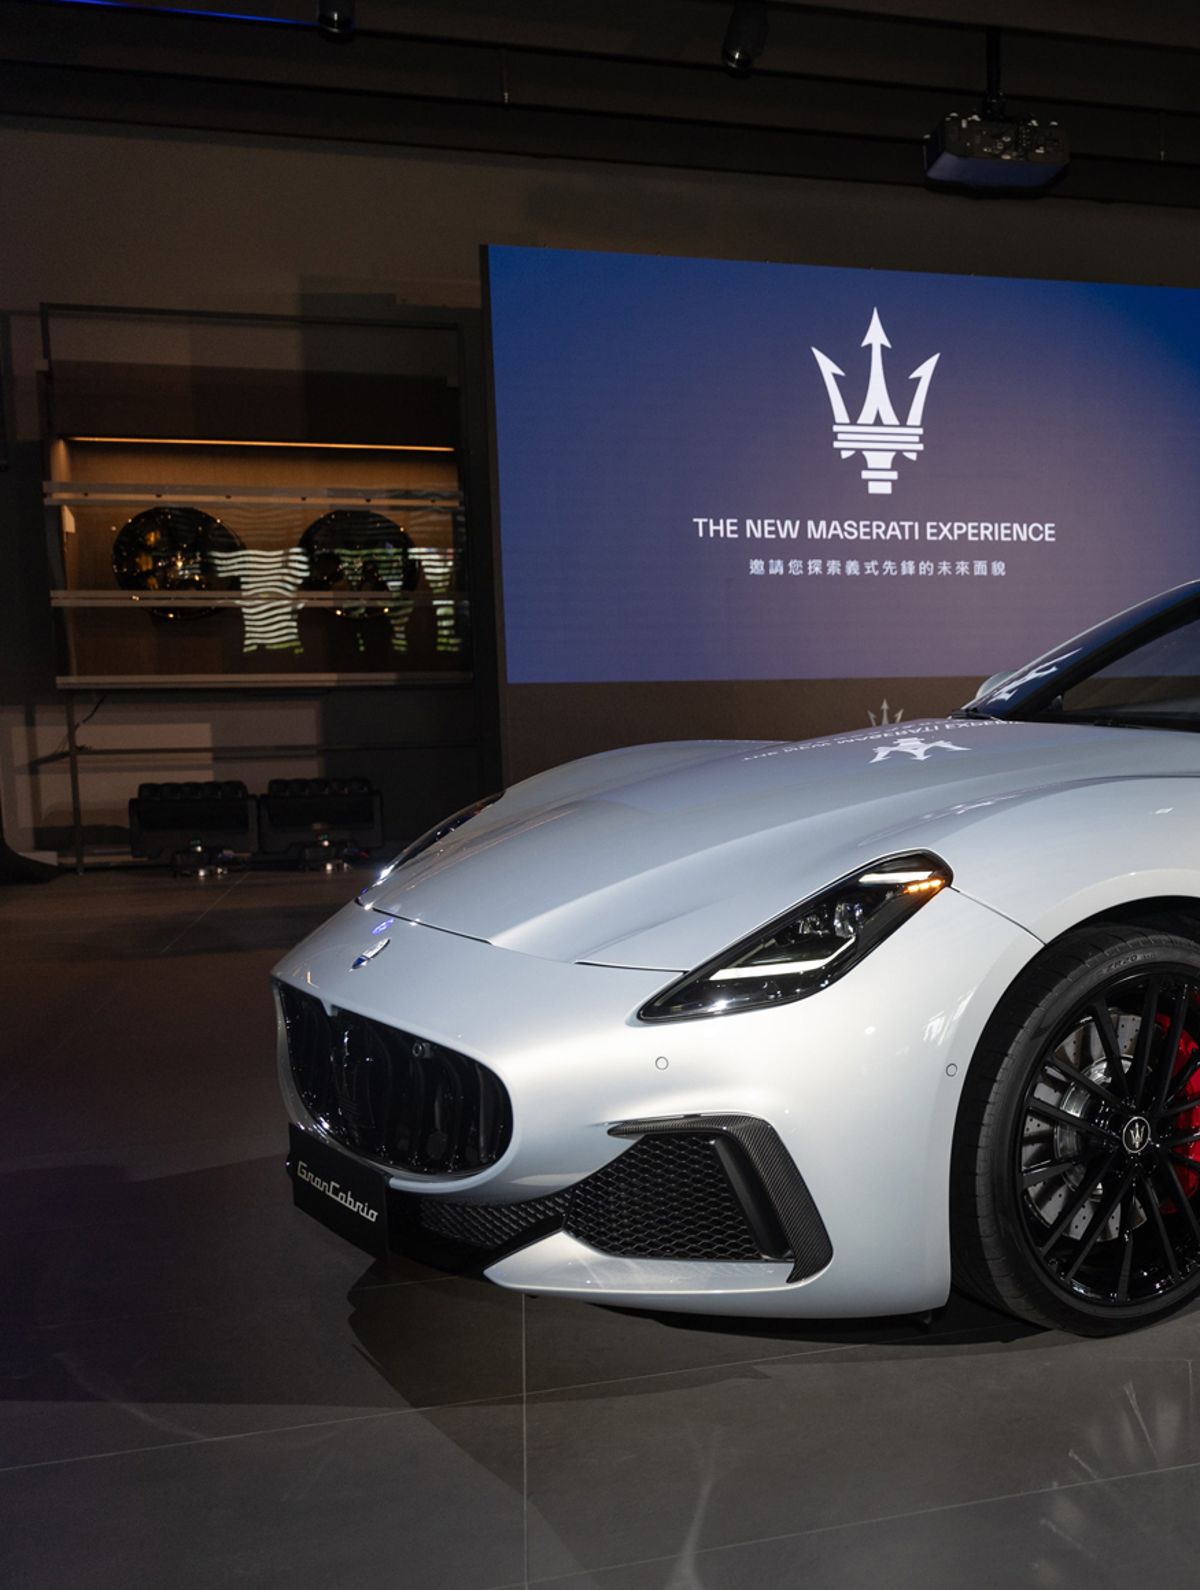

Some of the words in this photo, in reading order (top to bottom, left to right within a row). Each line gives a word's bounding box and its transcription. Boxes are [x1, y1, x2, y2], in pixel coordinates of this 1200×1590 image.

[693, 518, 739, 538] THE
[745, 518, 800, 539] NEW
[807, 519, 919, 541] MASERATI
[926, 521, 1056, 542] EXPERIENCE
[297, 1161, 379, 1222] GranCabrio
